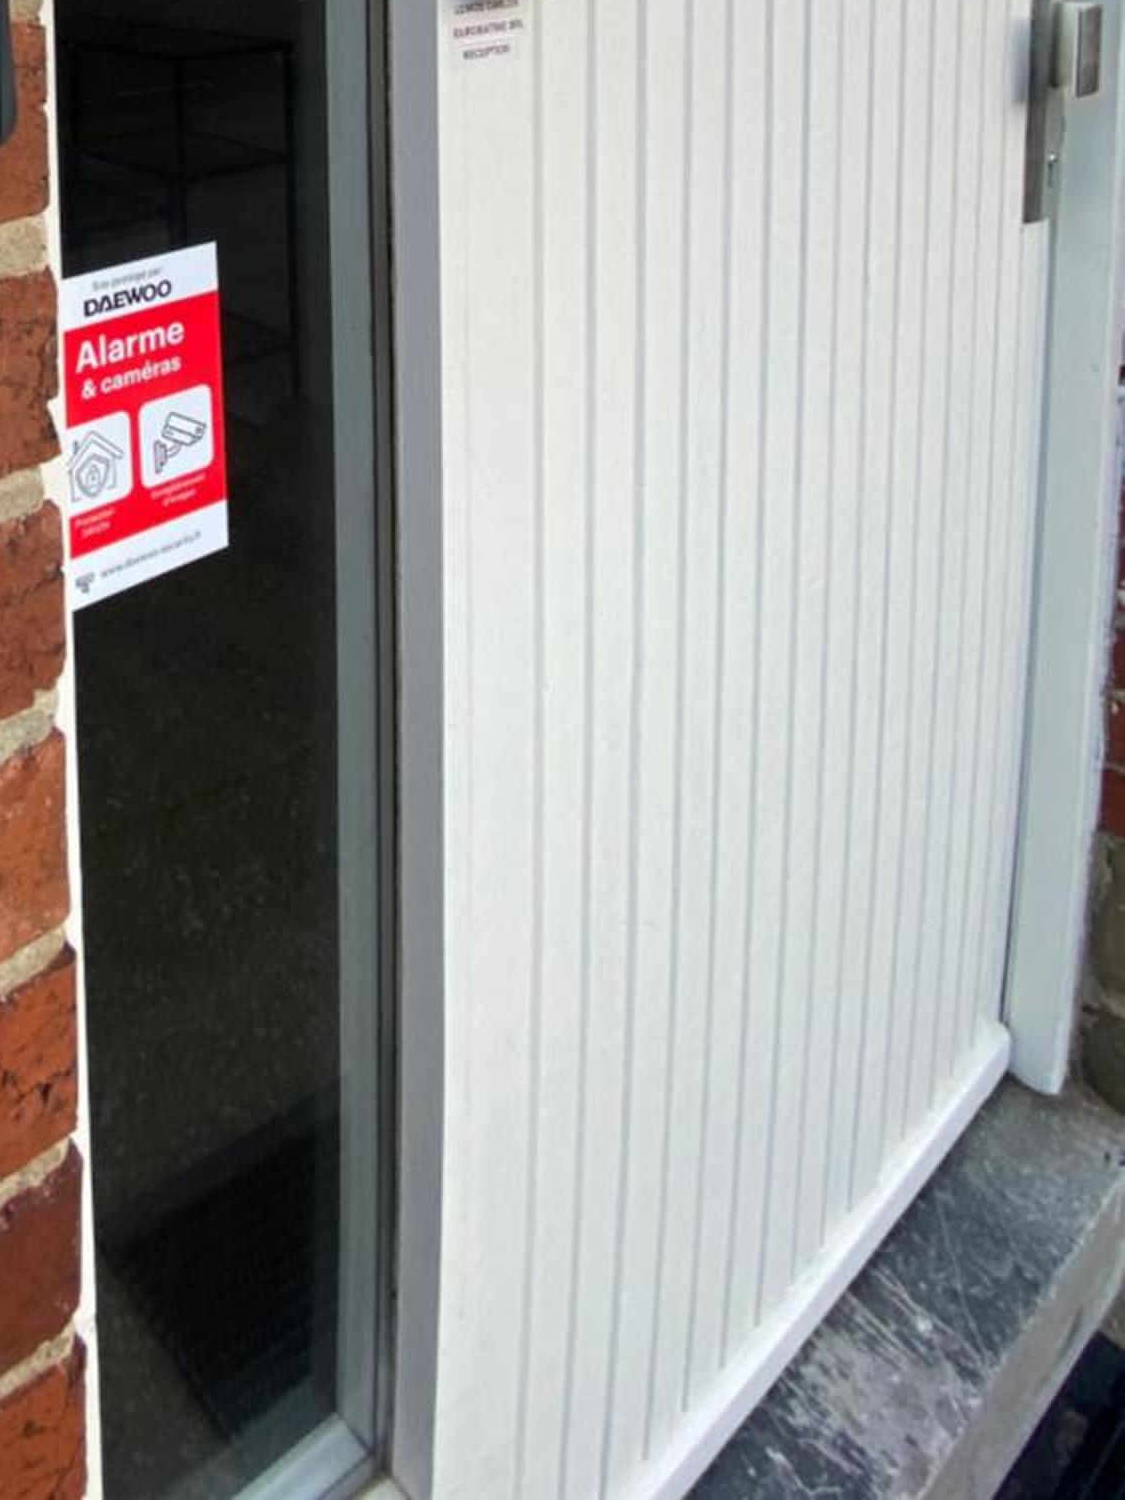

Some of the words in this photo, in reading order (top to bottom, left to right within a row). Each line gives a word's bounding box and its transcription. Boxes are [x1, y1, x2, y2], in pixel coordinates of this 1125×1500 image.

[83, 279, 172, 317] DAEWOO
[75, 321, 185, 374] Alarme
[80, 380, 96, 400] &
[100, 355, 182, 395] caméras
